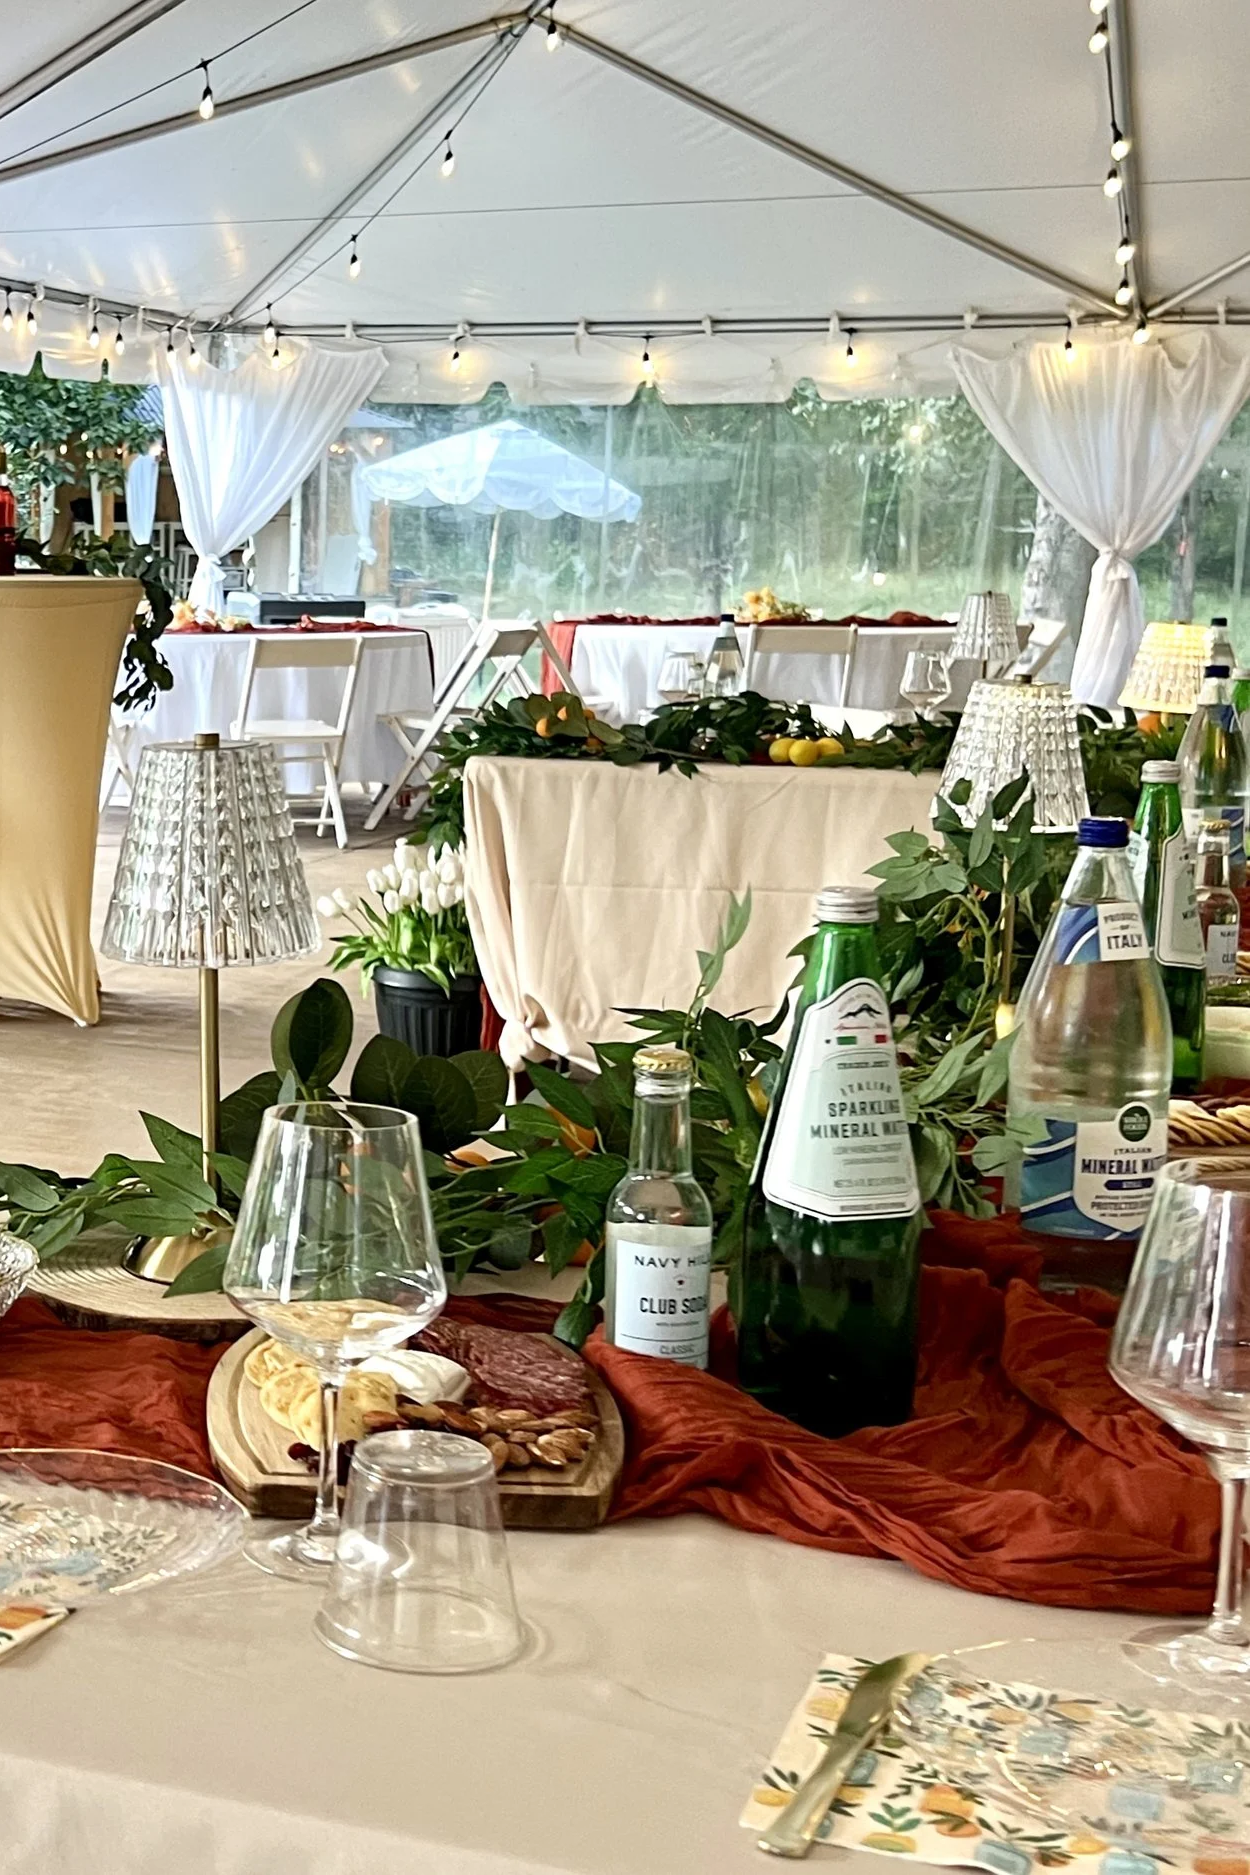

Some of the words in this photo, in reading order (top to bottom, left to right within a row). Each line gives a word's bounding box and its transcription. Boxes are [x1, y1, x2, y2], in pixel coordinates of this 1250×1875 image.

[1107, 934, 1143, 950] ITALY
[811, 1122, 879, 1138] MINERAL
[1081, 1158, 1138, 1174] MINERAL
[634, 1255, 681, 1268] NAVY
[639, 1297, 677, 1314] CLUB
